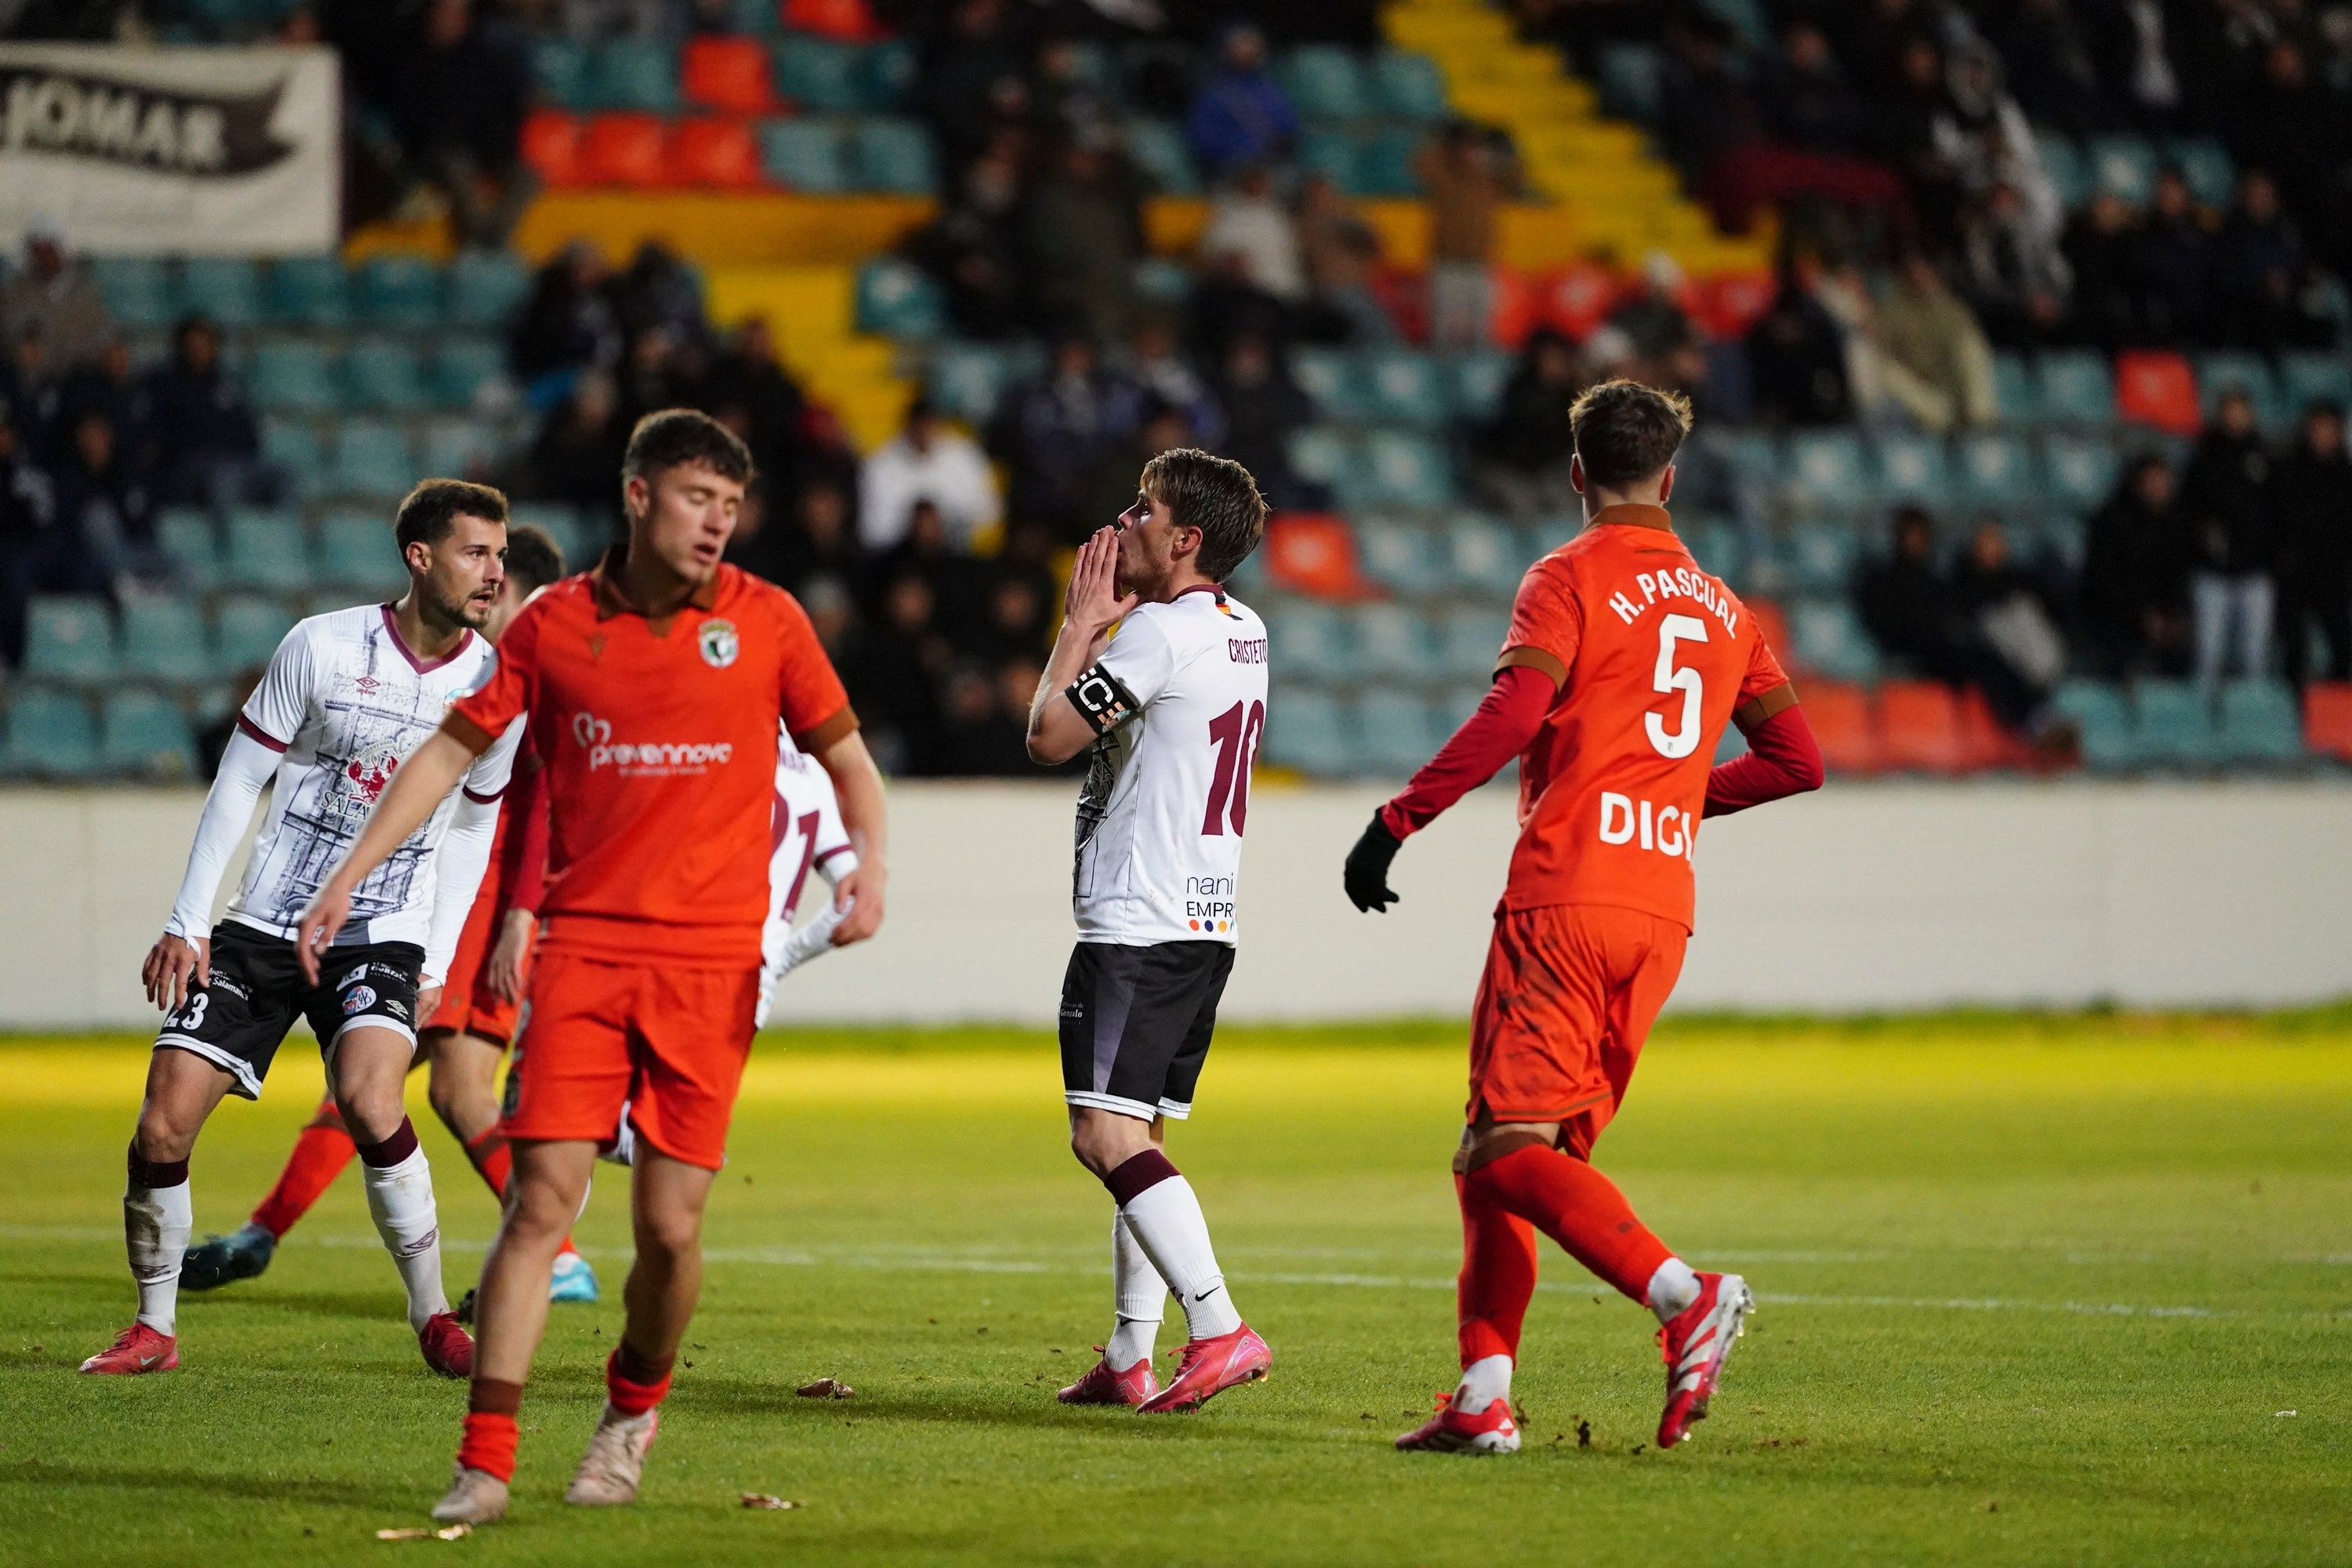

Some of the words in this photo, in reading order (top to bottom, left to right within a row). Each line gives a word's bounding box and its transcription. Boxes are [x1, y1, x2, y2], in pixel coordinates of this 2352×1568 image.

[1229, 638, 1267, 664] CRISTETO
[1079, 677, 1113, 711] C
[1645, 613, 1709, 759] 5
[1201, 699, 1265, 837] 10
[1599, 792, 1693, 862] DIGI
[1187, 872, 1233, 895] nani
[1186, 901, 1236, 918] EMPR
[212, 976, 249, 1001] Salamana
